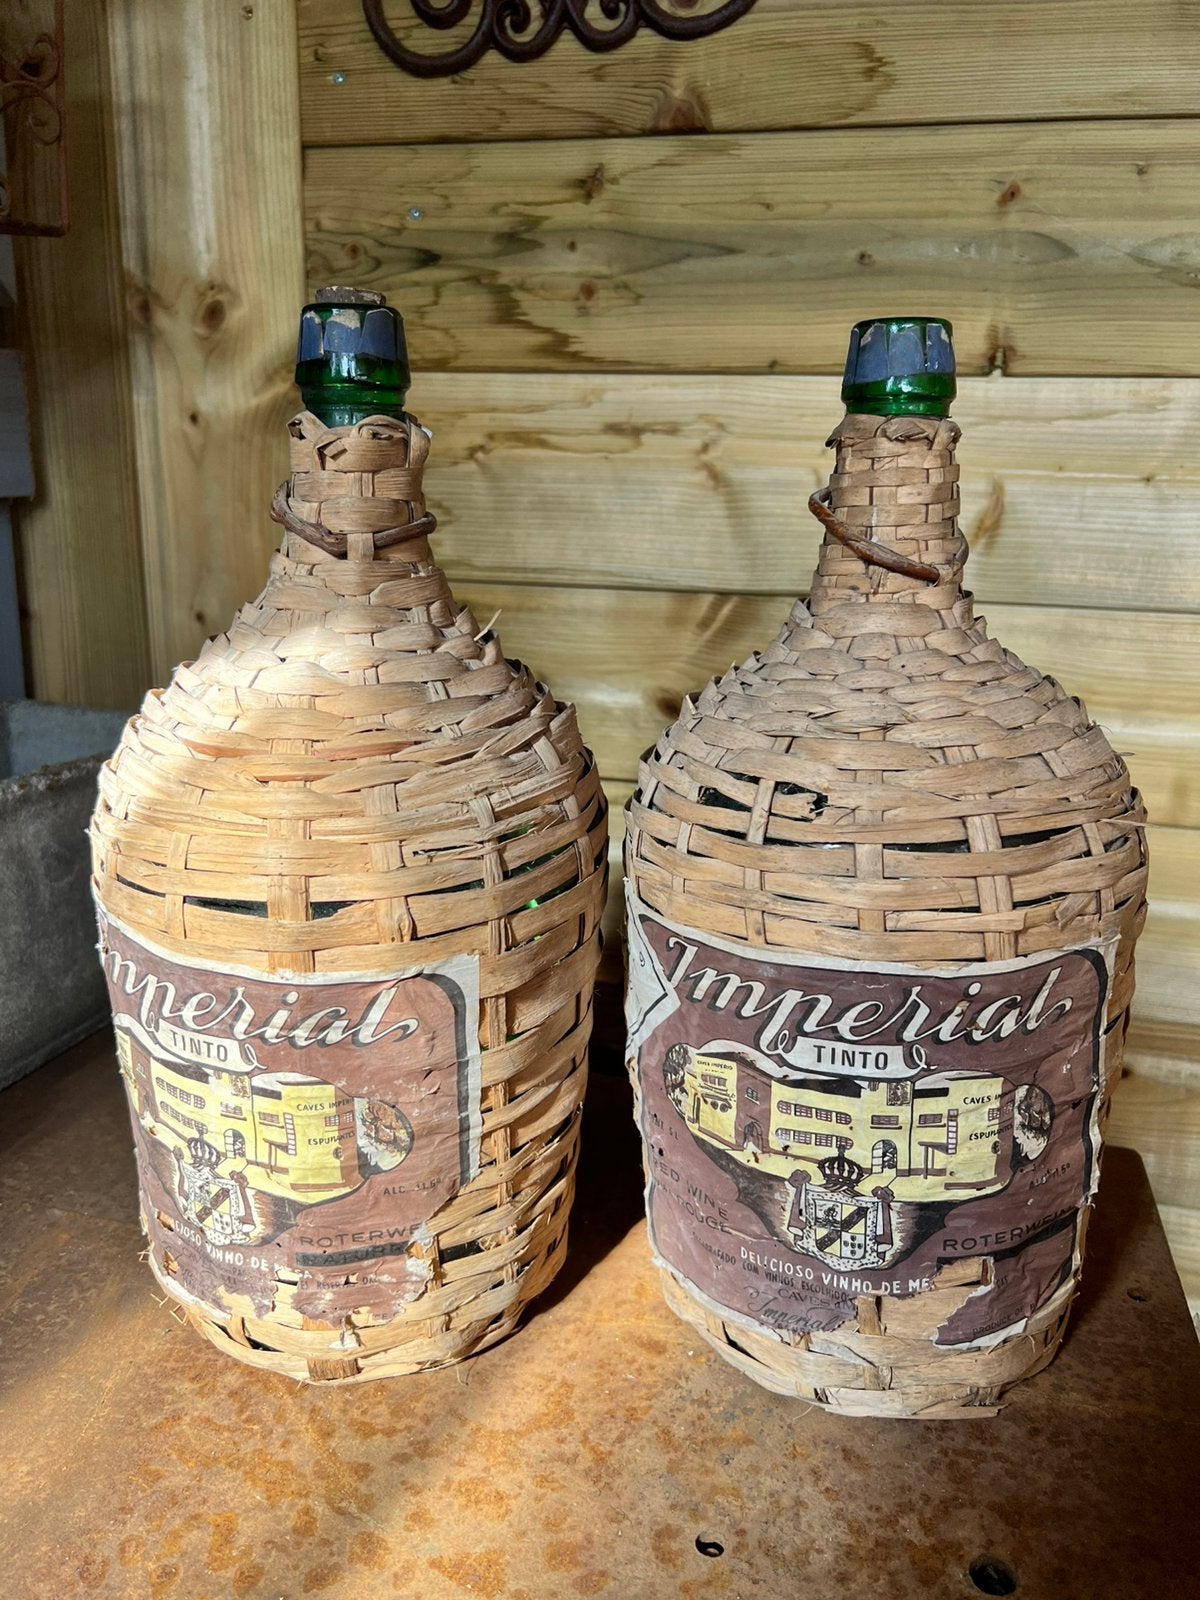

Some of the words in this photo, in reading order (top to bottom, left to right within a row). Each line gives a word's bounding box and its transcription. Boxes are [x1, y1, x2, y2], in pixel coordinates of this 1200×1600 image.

[106, 950, 420, 1047] mperial
[666, 936, 1073, 1054] Imperial
[170, 1029, 229, 1062] TINTO
[813, 1044, 889, 1071] TINTO
[296, 1102, 325, 1112] CAVES
[963, 1094, 991, 1105] CAVES
[686, 1181, 729, 1221] WINE
[300, 1222, 424, 1247] ROTERWE
[250, 1256, 270, 1272] DE
[741, 1246, 814, 1280] DELICIOSO
[822, 1272, 873, 1293] VINHO
[881, 1278, 901, 1293] DE
[908, 1278, 930, 1292] ME
[742, 1262, 760, 1275] COM
[778, 1288, 831, 1307] CAVES
